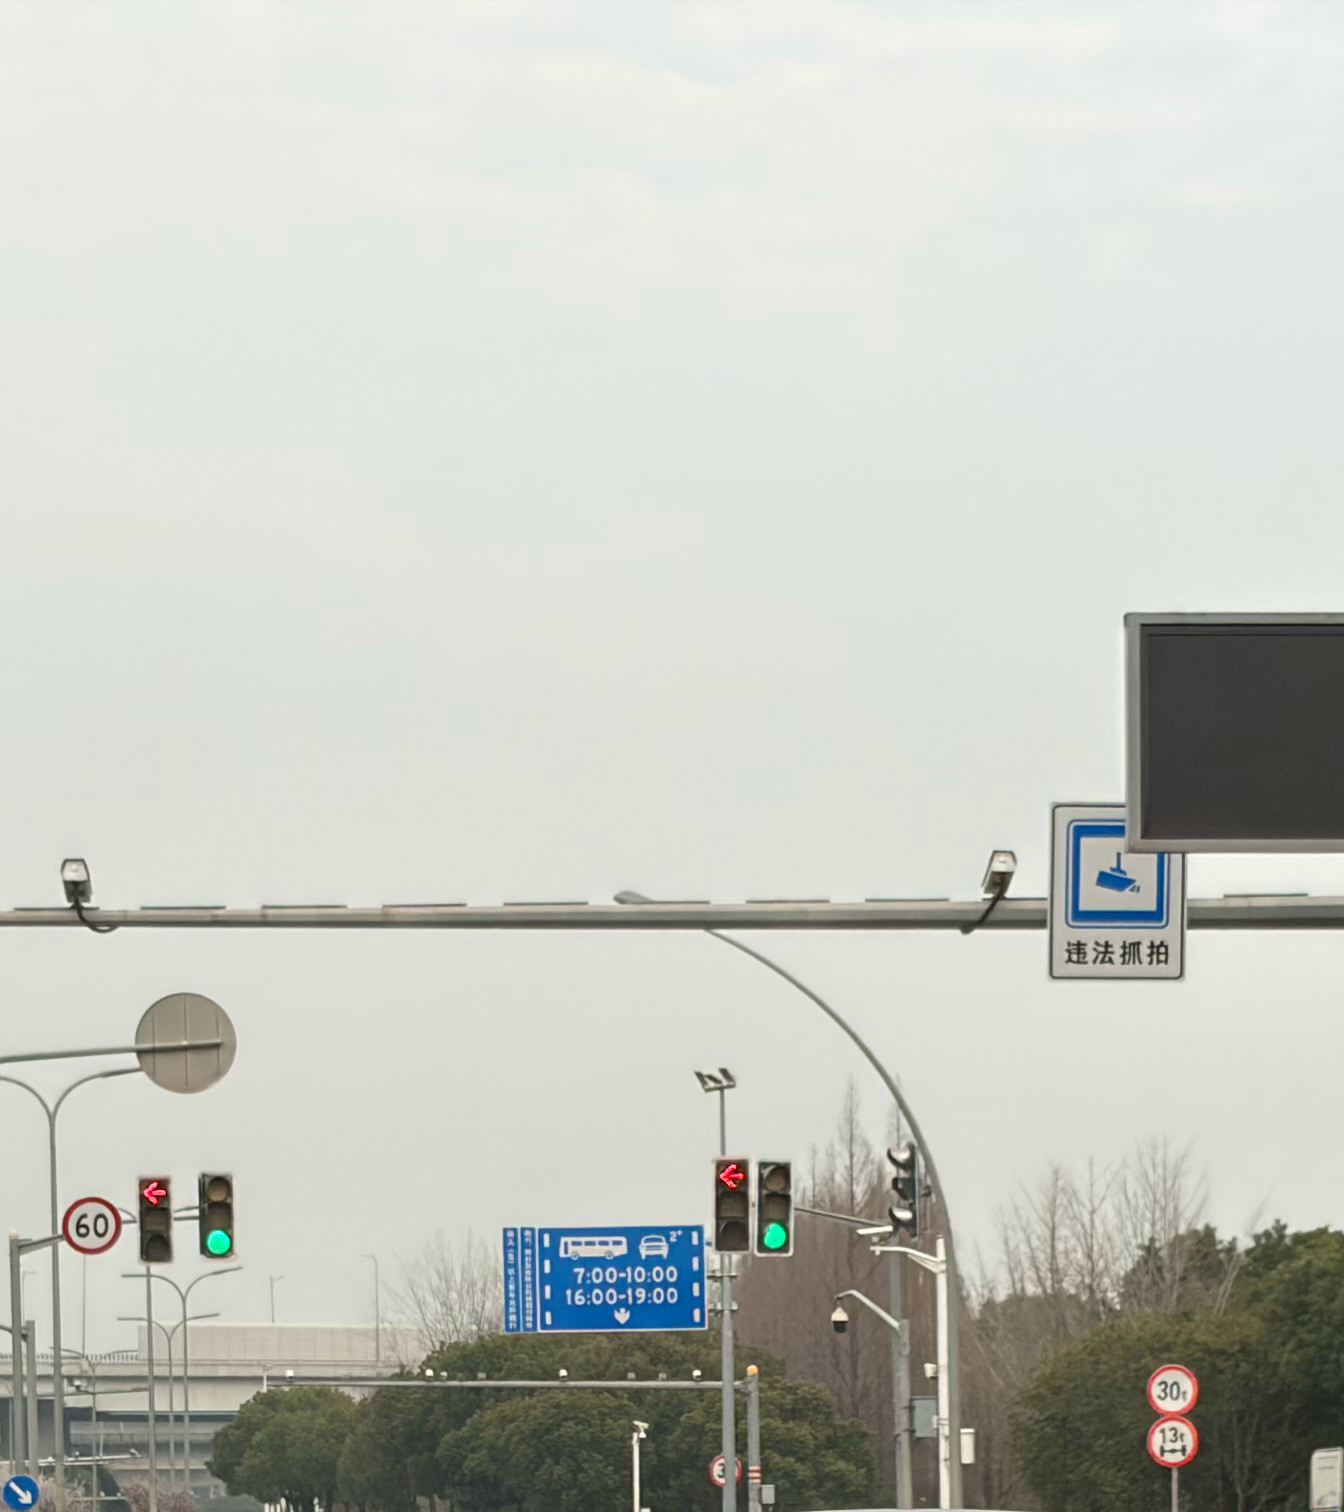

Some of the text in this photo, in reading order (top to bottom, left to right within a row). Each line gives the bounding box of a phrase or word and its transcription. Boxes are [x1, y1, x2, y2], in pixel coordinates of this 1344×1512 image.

[1065, 940, 1169, 965] 违法抓拍
[76, 1213, 109, 1238] 60
[573, 1266, 678, 1284] 7:00-10:00
[566, 1288, 679, 1306] 16:00-19:00
